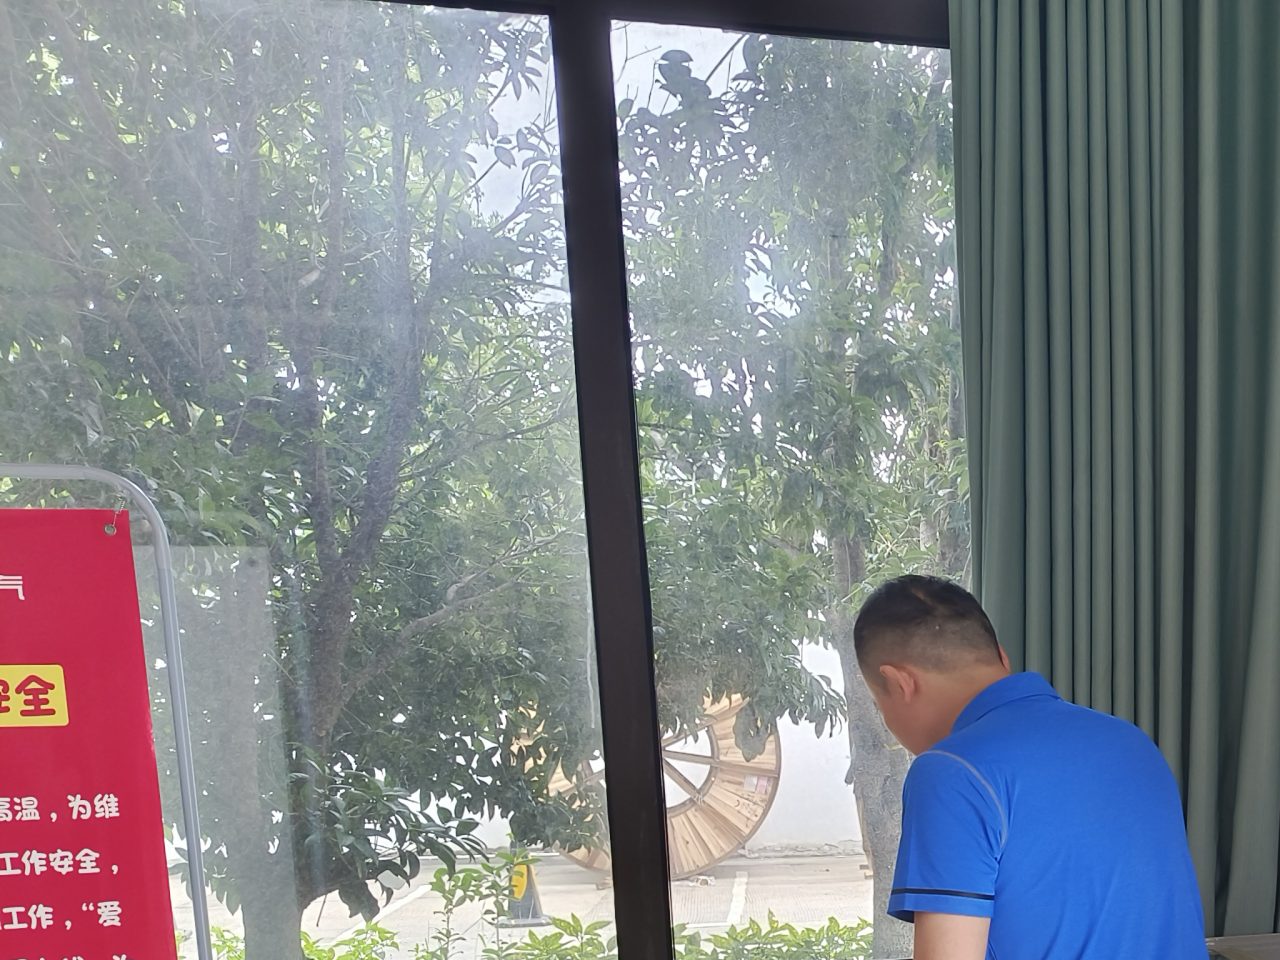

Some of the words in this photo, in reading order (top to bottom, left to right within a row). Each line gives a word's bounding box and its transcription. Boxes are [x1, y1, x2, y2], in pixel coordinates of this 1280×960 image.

[0, 674, 56, 717] 全
[0, 848, 119, 876] 工作安全，
[0, 900, 122, 930] 工作，“爱
